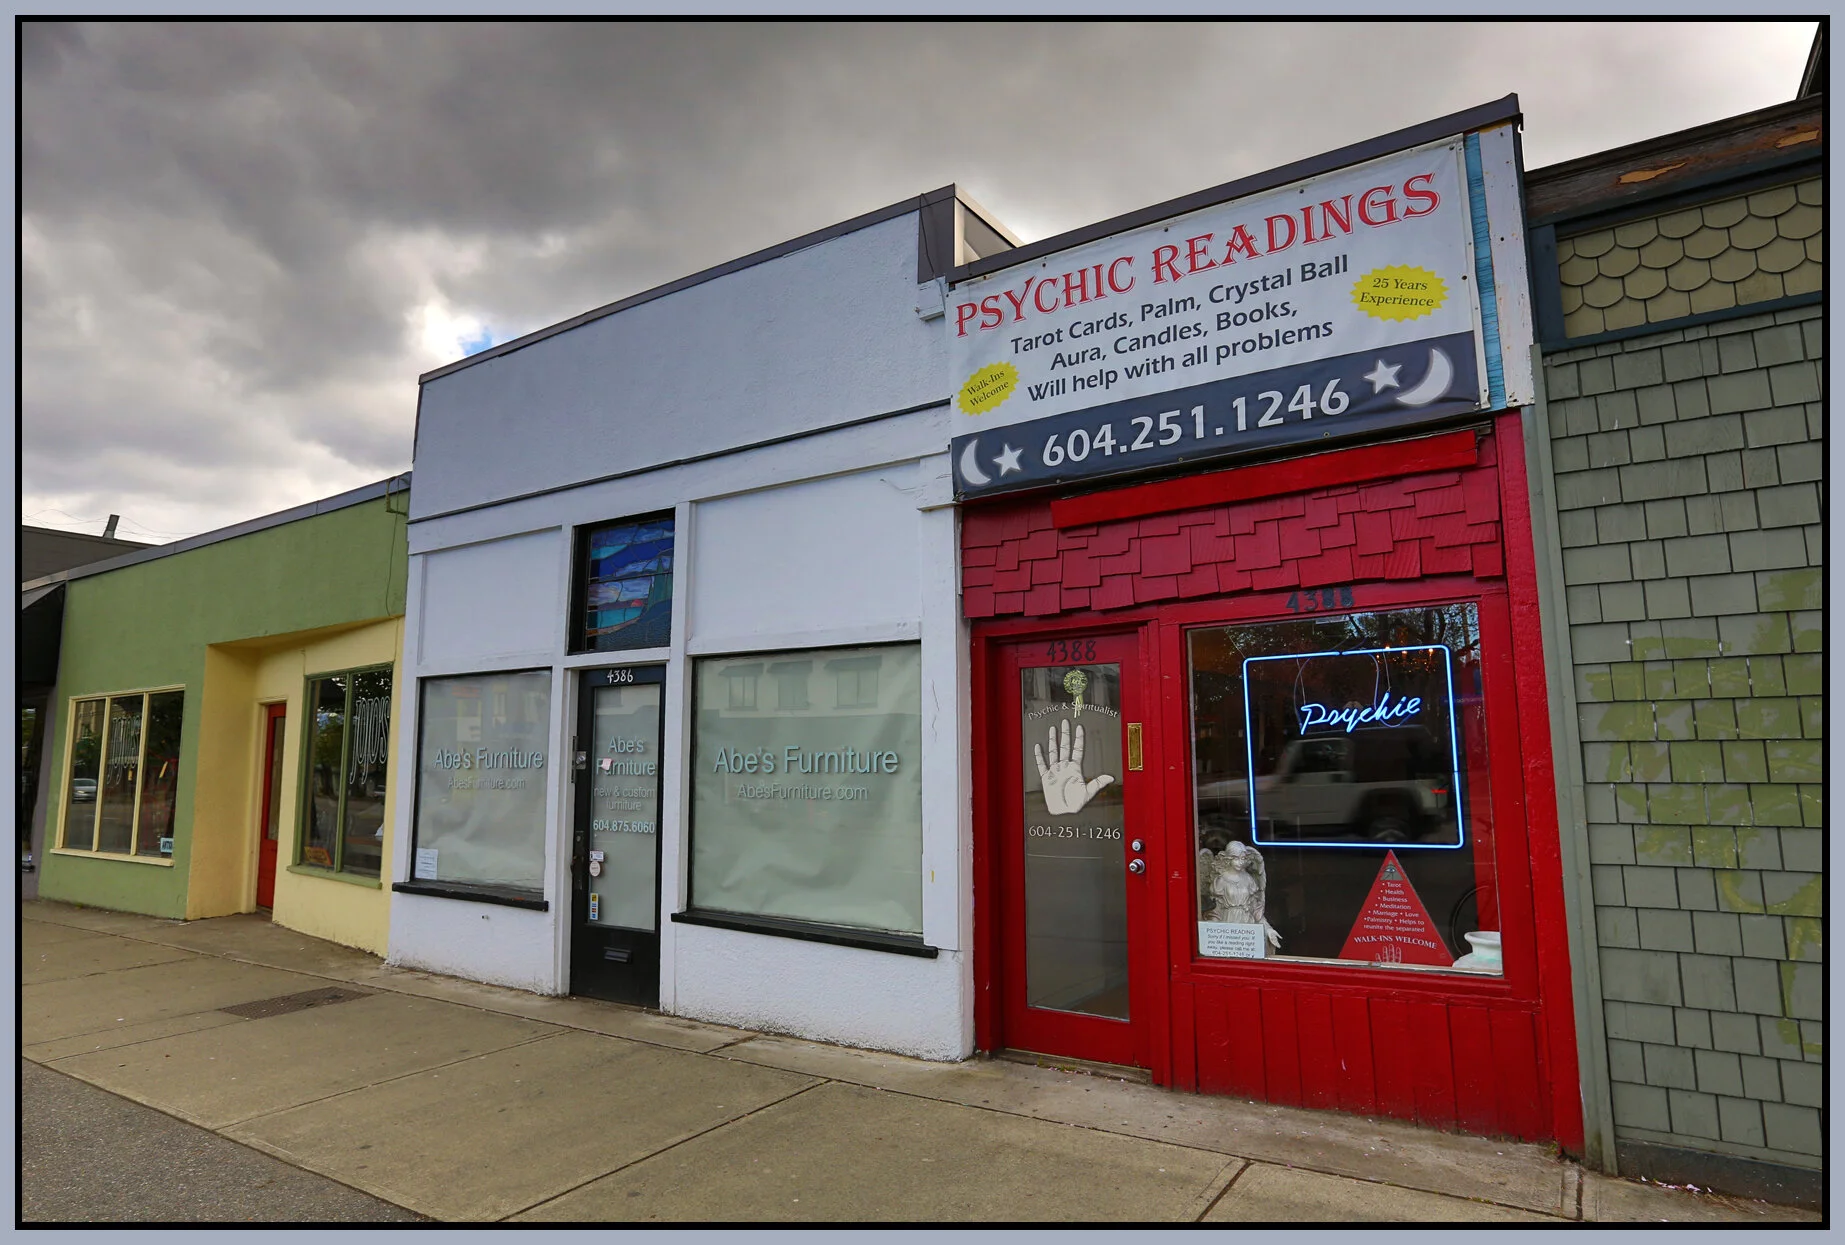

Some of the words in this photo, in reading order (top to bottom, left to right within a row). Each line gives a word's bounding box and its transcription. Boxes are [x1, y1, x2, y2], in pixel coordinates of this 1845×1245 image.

[955, 256, 1136, 338] PSYCHIC
[1152, 172, 1441, 284] READINGS
[1373, 278, 1389, 289] 25
[1394, 279, 1428, 291] Years
[1010, 328, 1064, 354] Tarot
[1069, 312, 1134, 339] Cards,
[1141, 297, 1202, 322] Palm,
[1209, 268, 1292, 304] Crystal
[1300, 254, 1348, 283] Ball
[1360, 292, 1434, 306] Experience
[1050, 346, 1107, 371] Aura,
[1114, 321, 1209, 355] Candles,
[1216, 301, 1298, 331] Books,
[1028, 377, 1066, 402] Will
[1073, 369, 1118, 392] help
[1124, 355, 1175, 380] with
[1182, 345, 1208, 368] all
[1216, 321, 1333, 365] problems
[967, 370, 1005, 395] Walk-Ins
[969, 381, 1009, 407] Welcome
[1042, 378, 1350, 467] 604.251.1246
[1285, 585, 1355, 613] 4388
[1046, 640, 1096, 662] 4388
[607, 669, 634, 684] 4386
[1028, 705, 1059, 720] Psychic
[1062, 702, 1070, 710] &
[1071, 701, 1118, 718] Siritualist
[608, 735, 645, 753] Abe's
[433, 747, 471, 769] Abe's
[475, 746, 545, 769] Furniture
[713, 746, 775, 774] Abe's
[783, 745, 899, 774] Furniture
[593, 787, 611, 797] new
[614, 786, 620, 797] &
[622, 786, 655, 798] custom
[737, 781, 868, 801] AbesFurniture.com
[606, 799, 642, 811] furniture
[593, 819, 655, 834] 604.875.6060
[1028, 825, 1121, 840] 604-251-1246
[1366, 916, 1393, 924] Palmistry
[1354, 935, 1394, 943] WALK-INS
[1395, 935, 1438, 949] WELCOME
